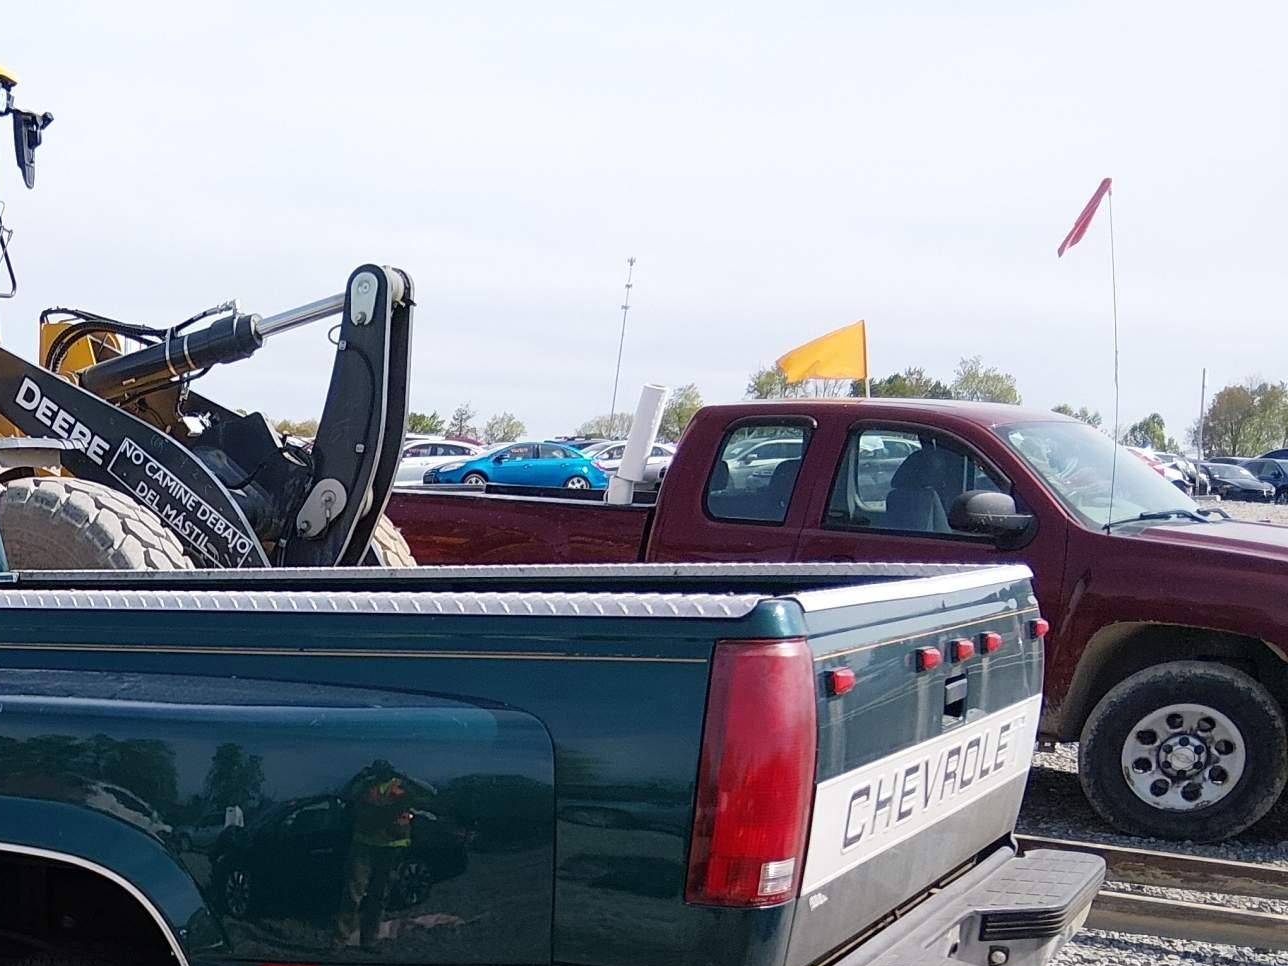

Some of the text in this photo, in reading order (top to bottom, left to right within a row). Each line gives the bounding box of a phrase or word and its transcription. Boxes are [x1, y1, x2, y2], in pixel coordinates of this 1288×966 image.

[15, 377, 110, 466] DEERE
[122, 441, 249, 554] NO CAMINE DEBAJO
[135, 481, 160, 511] DEL
